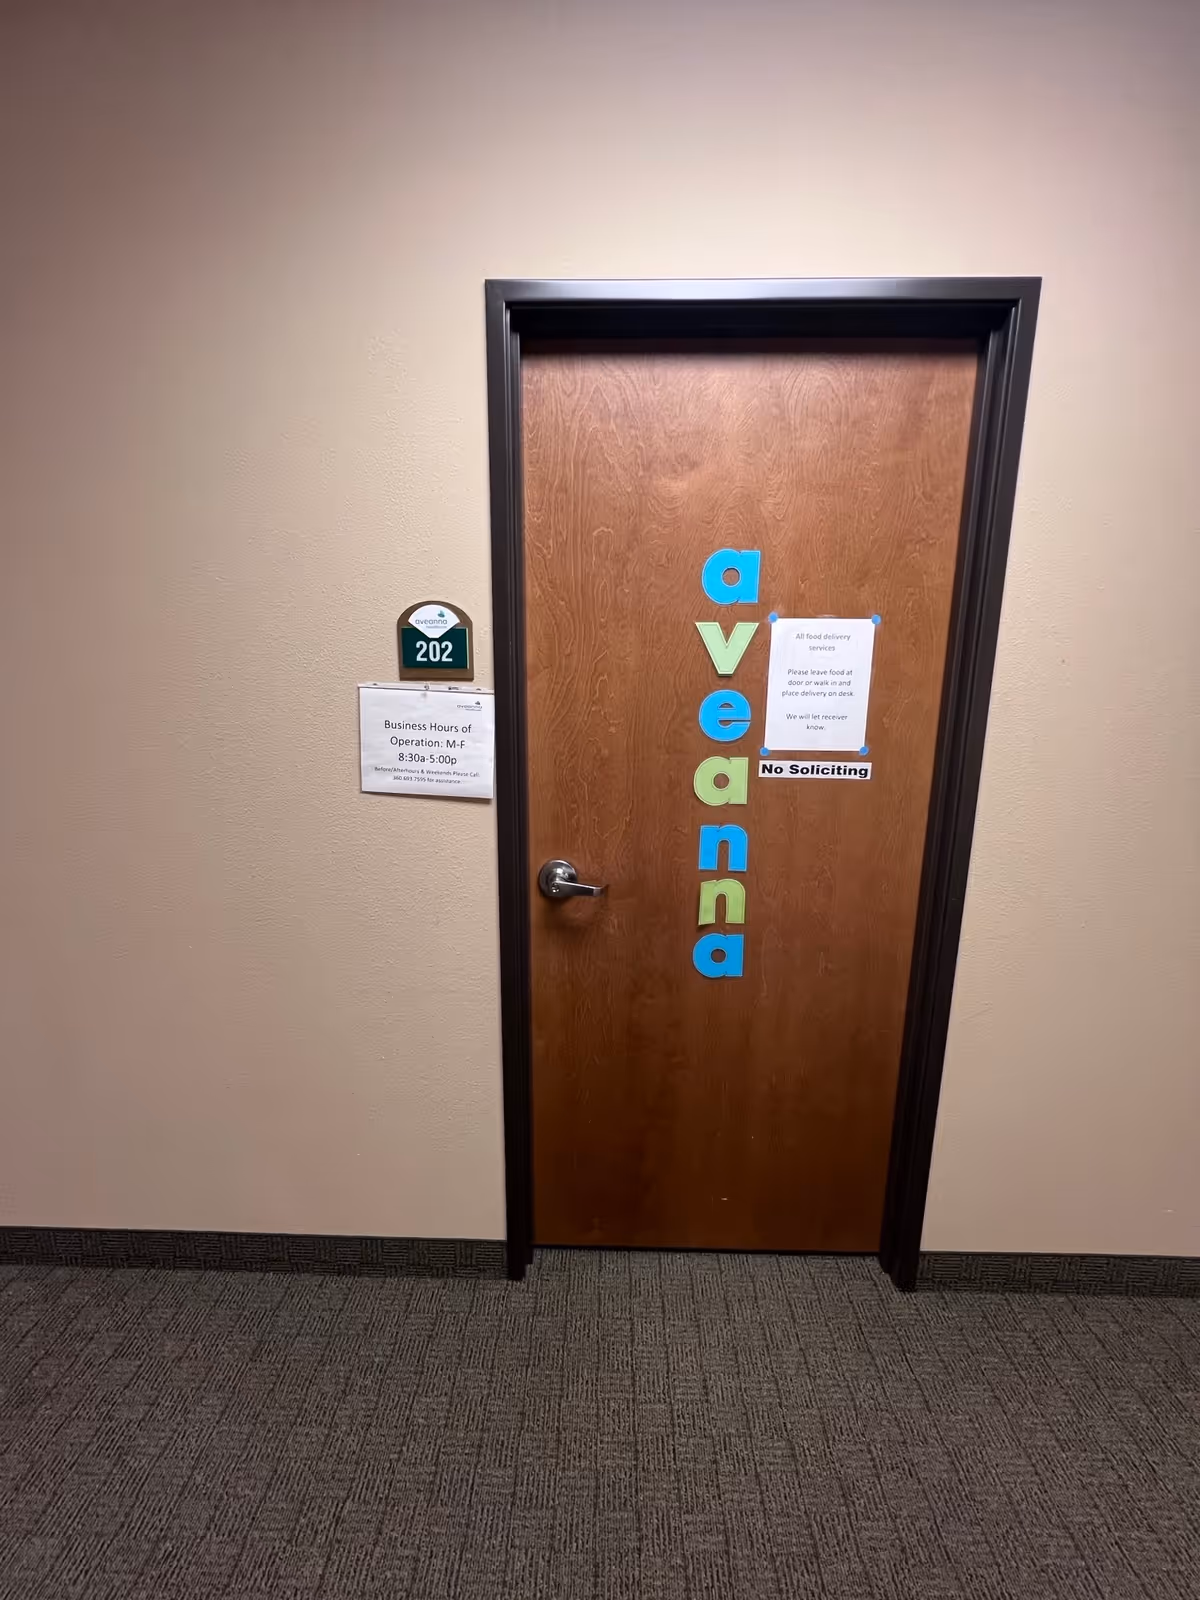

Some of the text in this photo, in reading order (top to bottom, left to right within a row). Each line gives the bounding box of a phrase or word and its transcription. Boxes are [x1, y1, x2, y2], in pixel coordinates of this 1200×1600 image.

[823, 633, 851, 642] delivery
[415, 640, 453, 662] 202
[787, 668, 809, 676] Please
[781, 690, 799, 698] place
[800, 690, 827, 698] delivery
[821, 713, 848, 721] receiver
[384, 719, 472, 733] Business Hours of
[390, 736, 466, 749] Operation: M-F
[398, 752, 457, 766] 8:30a-5:00p
[692, 548, 761, 978] aveanna
[761, 763, 869, 778] No Soliciting
